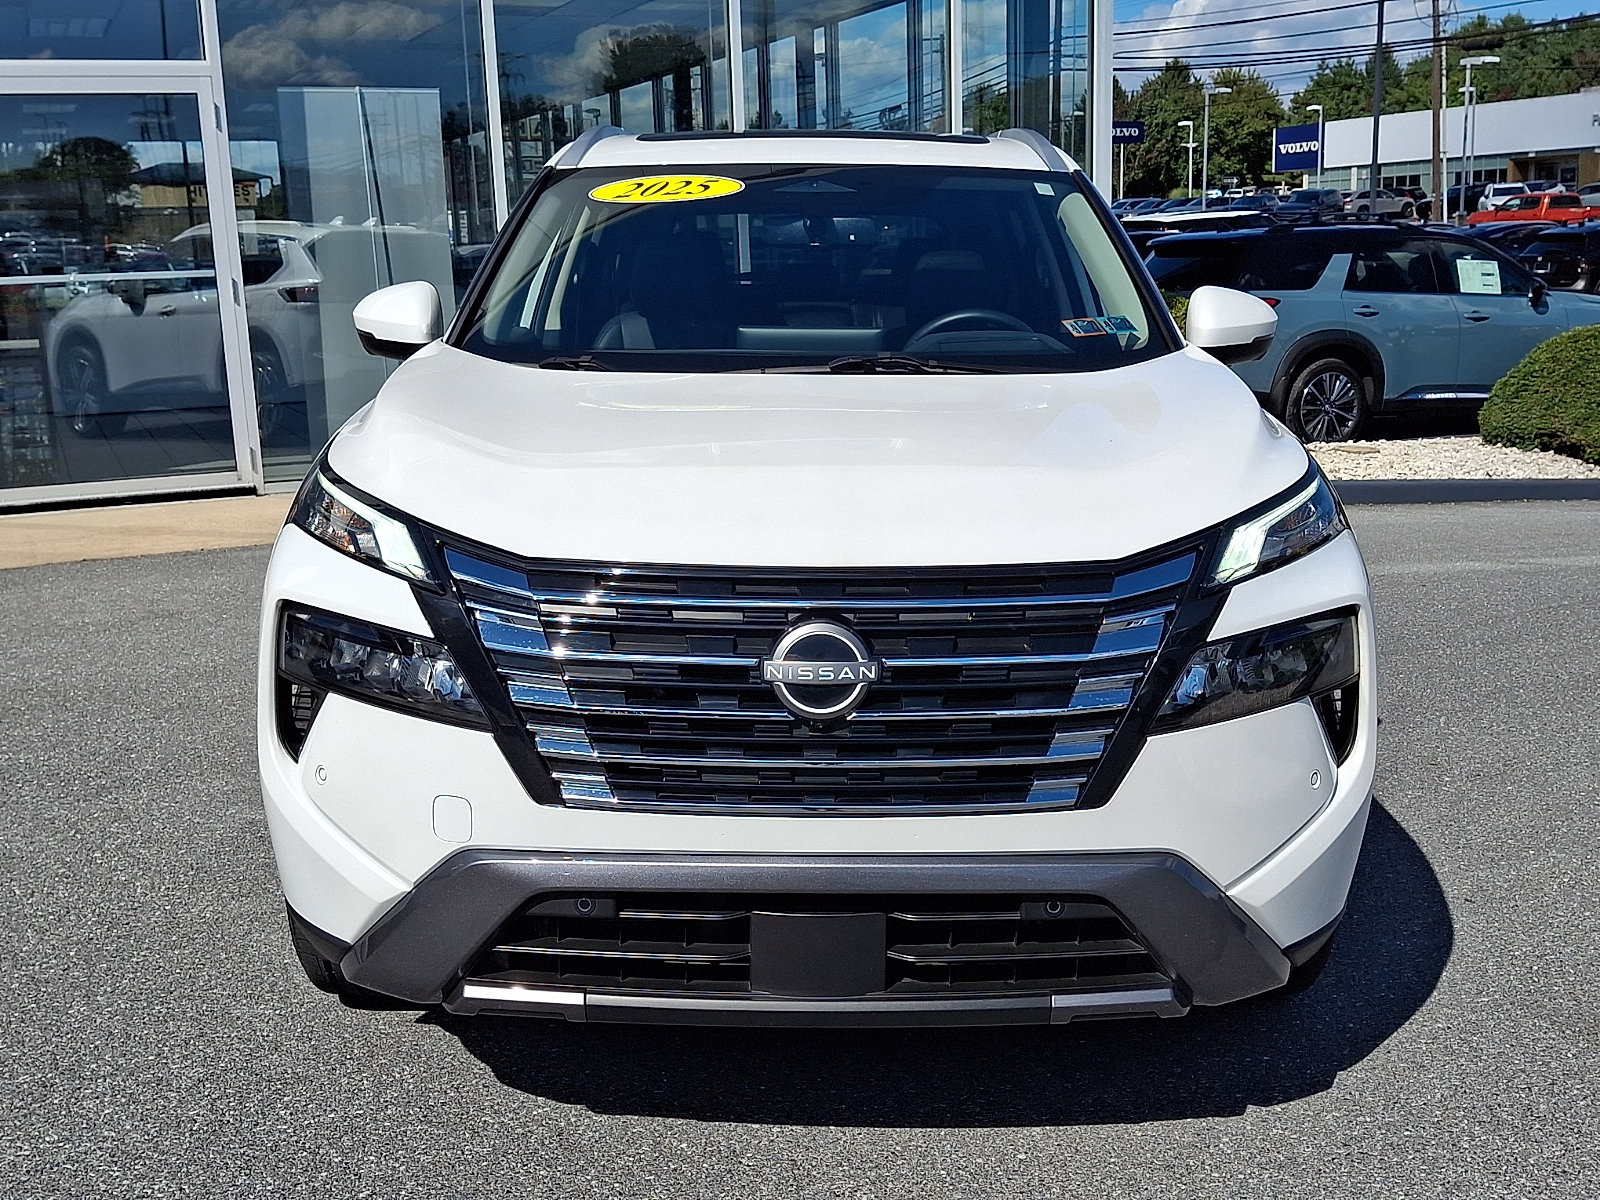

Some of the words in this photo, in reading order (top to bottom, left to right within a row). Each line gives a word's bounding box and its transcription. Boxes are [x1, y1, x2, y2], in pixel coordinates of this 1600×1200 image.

[1111, 128, 1139, 136] OLVO
[1278, 141, 1319, 154] VOLVO
[612, 180, 719, 199] 2025
[766, 665, 876, 680] NISSAN
